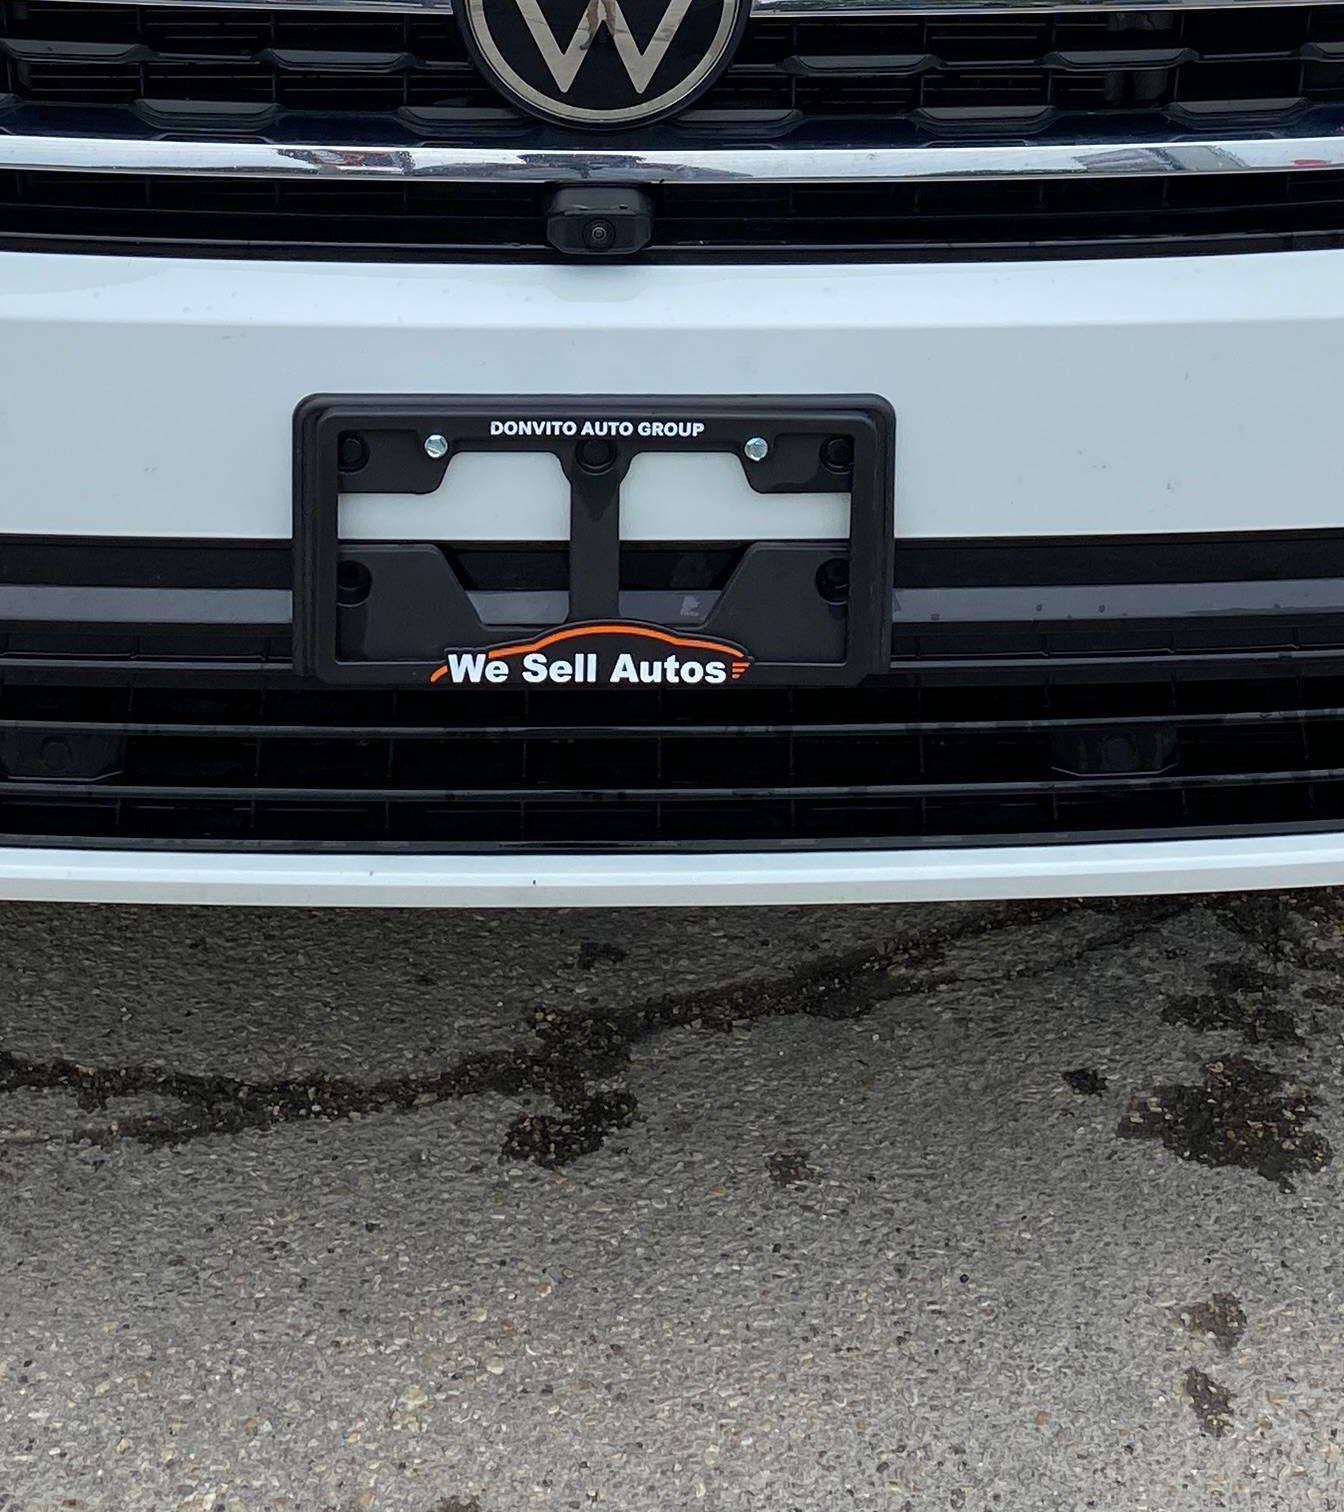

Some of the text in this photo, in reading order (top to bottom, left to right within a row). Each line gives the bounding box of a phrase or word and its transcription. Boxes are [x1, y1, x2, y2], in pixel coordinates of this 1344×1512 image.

[490, 421, 705, 437] DONVITO AUTO GROUP
[447, 652, 727, 683] We Sell Autos
